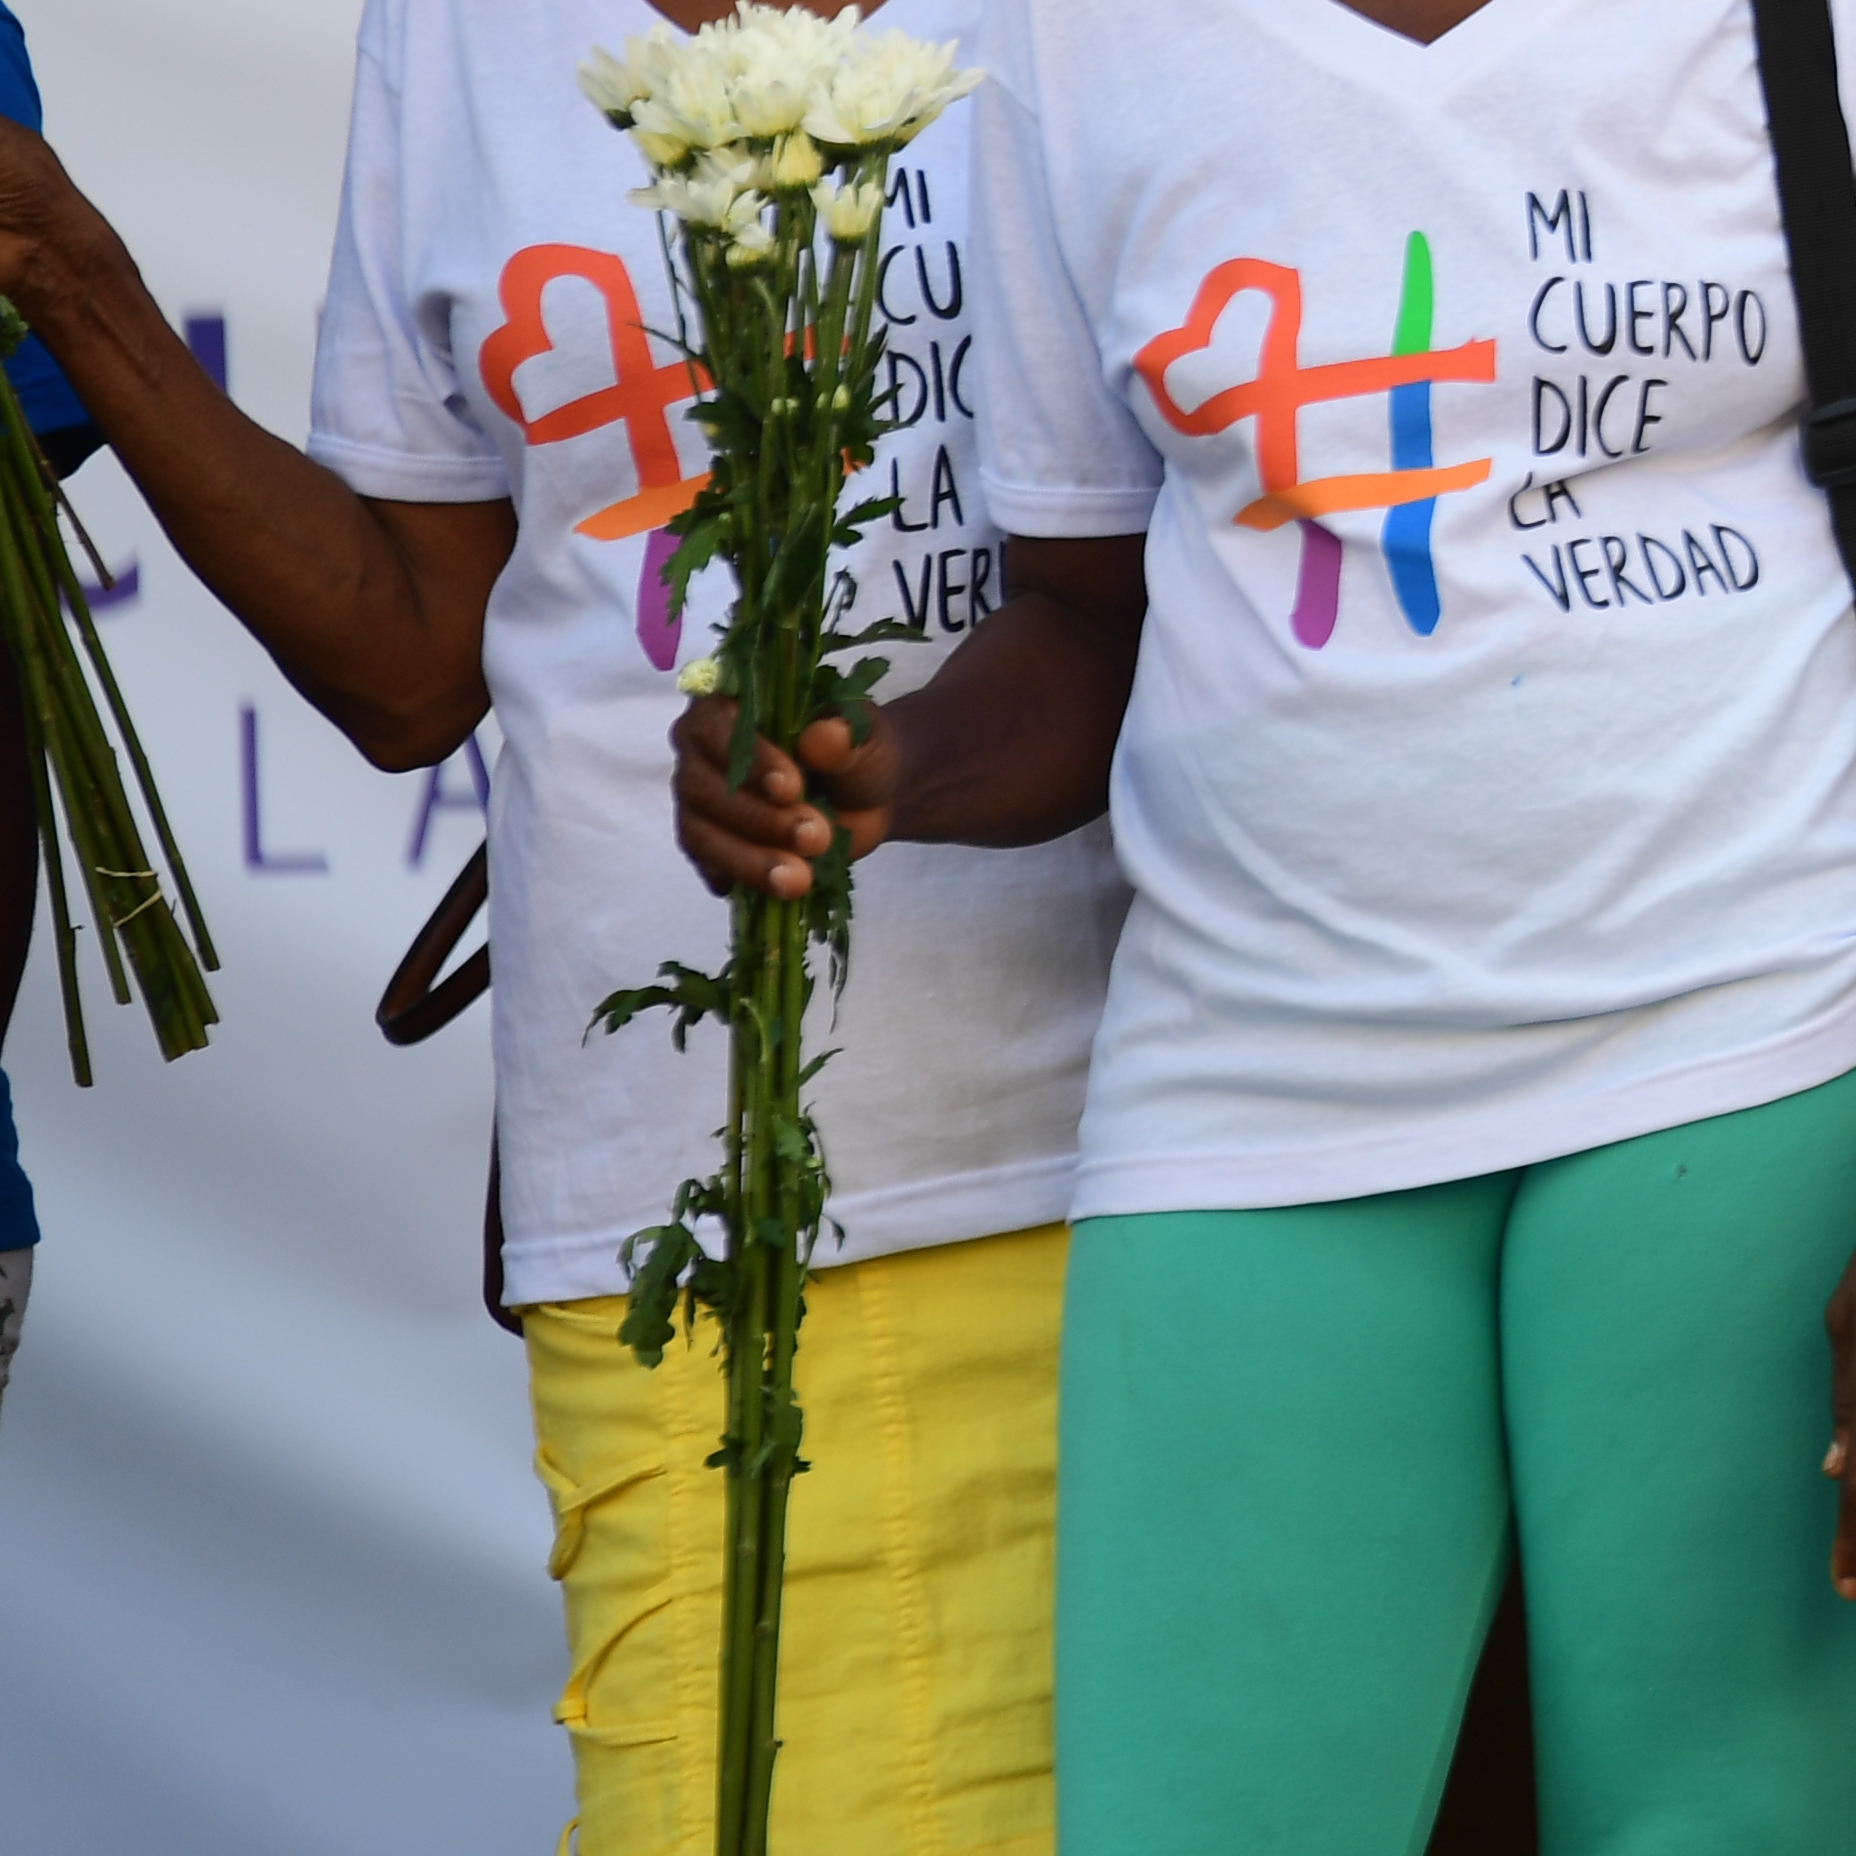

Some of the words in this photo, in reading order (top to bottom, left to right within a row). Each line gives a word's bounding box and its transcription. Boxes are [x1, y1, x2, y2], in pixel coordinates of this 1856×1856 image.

[1524, 188, 1593, 264] MI
[1526, 276, 1767, 367] CUERPO
[886, 334, 975, 425] DIC
[1530, 373, 1669, 459] DICE
[889, 443, 964, 534] LA
[892, 540, 1005, 633] VER
[1519, 523, 1760, 614] VERDAD
